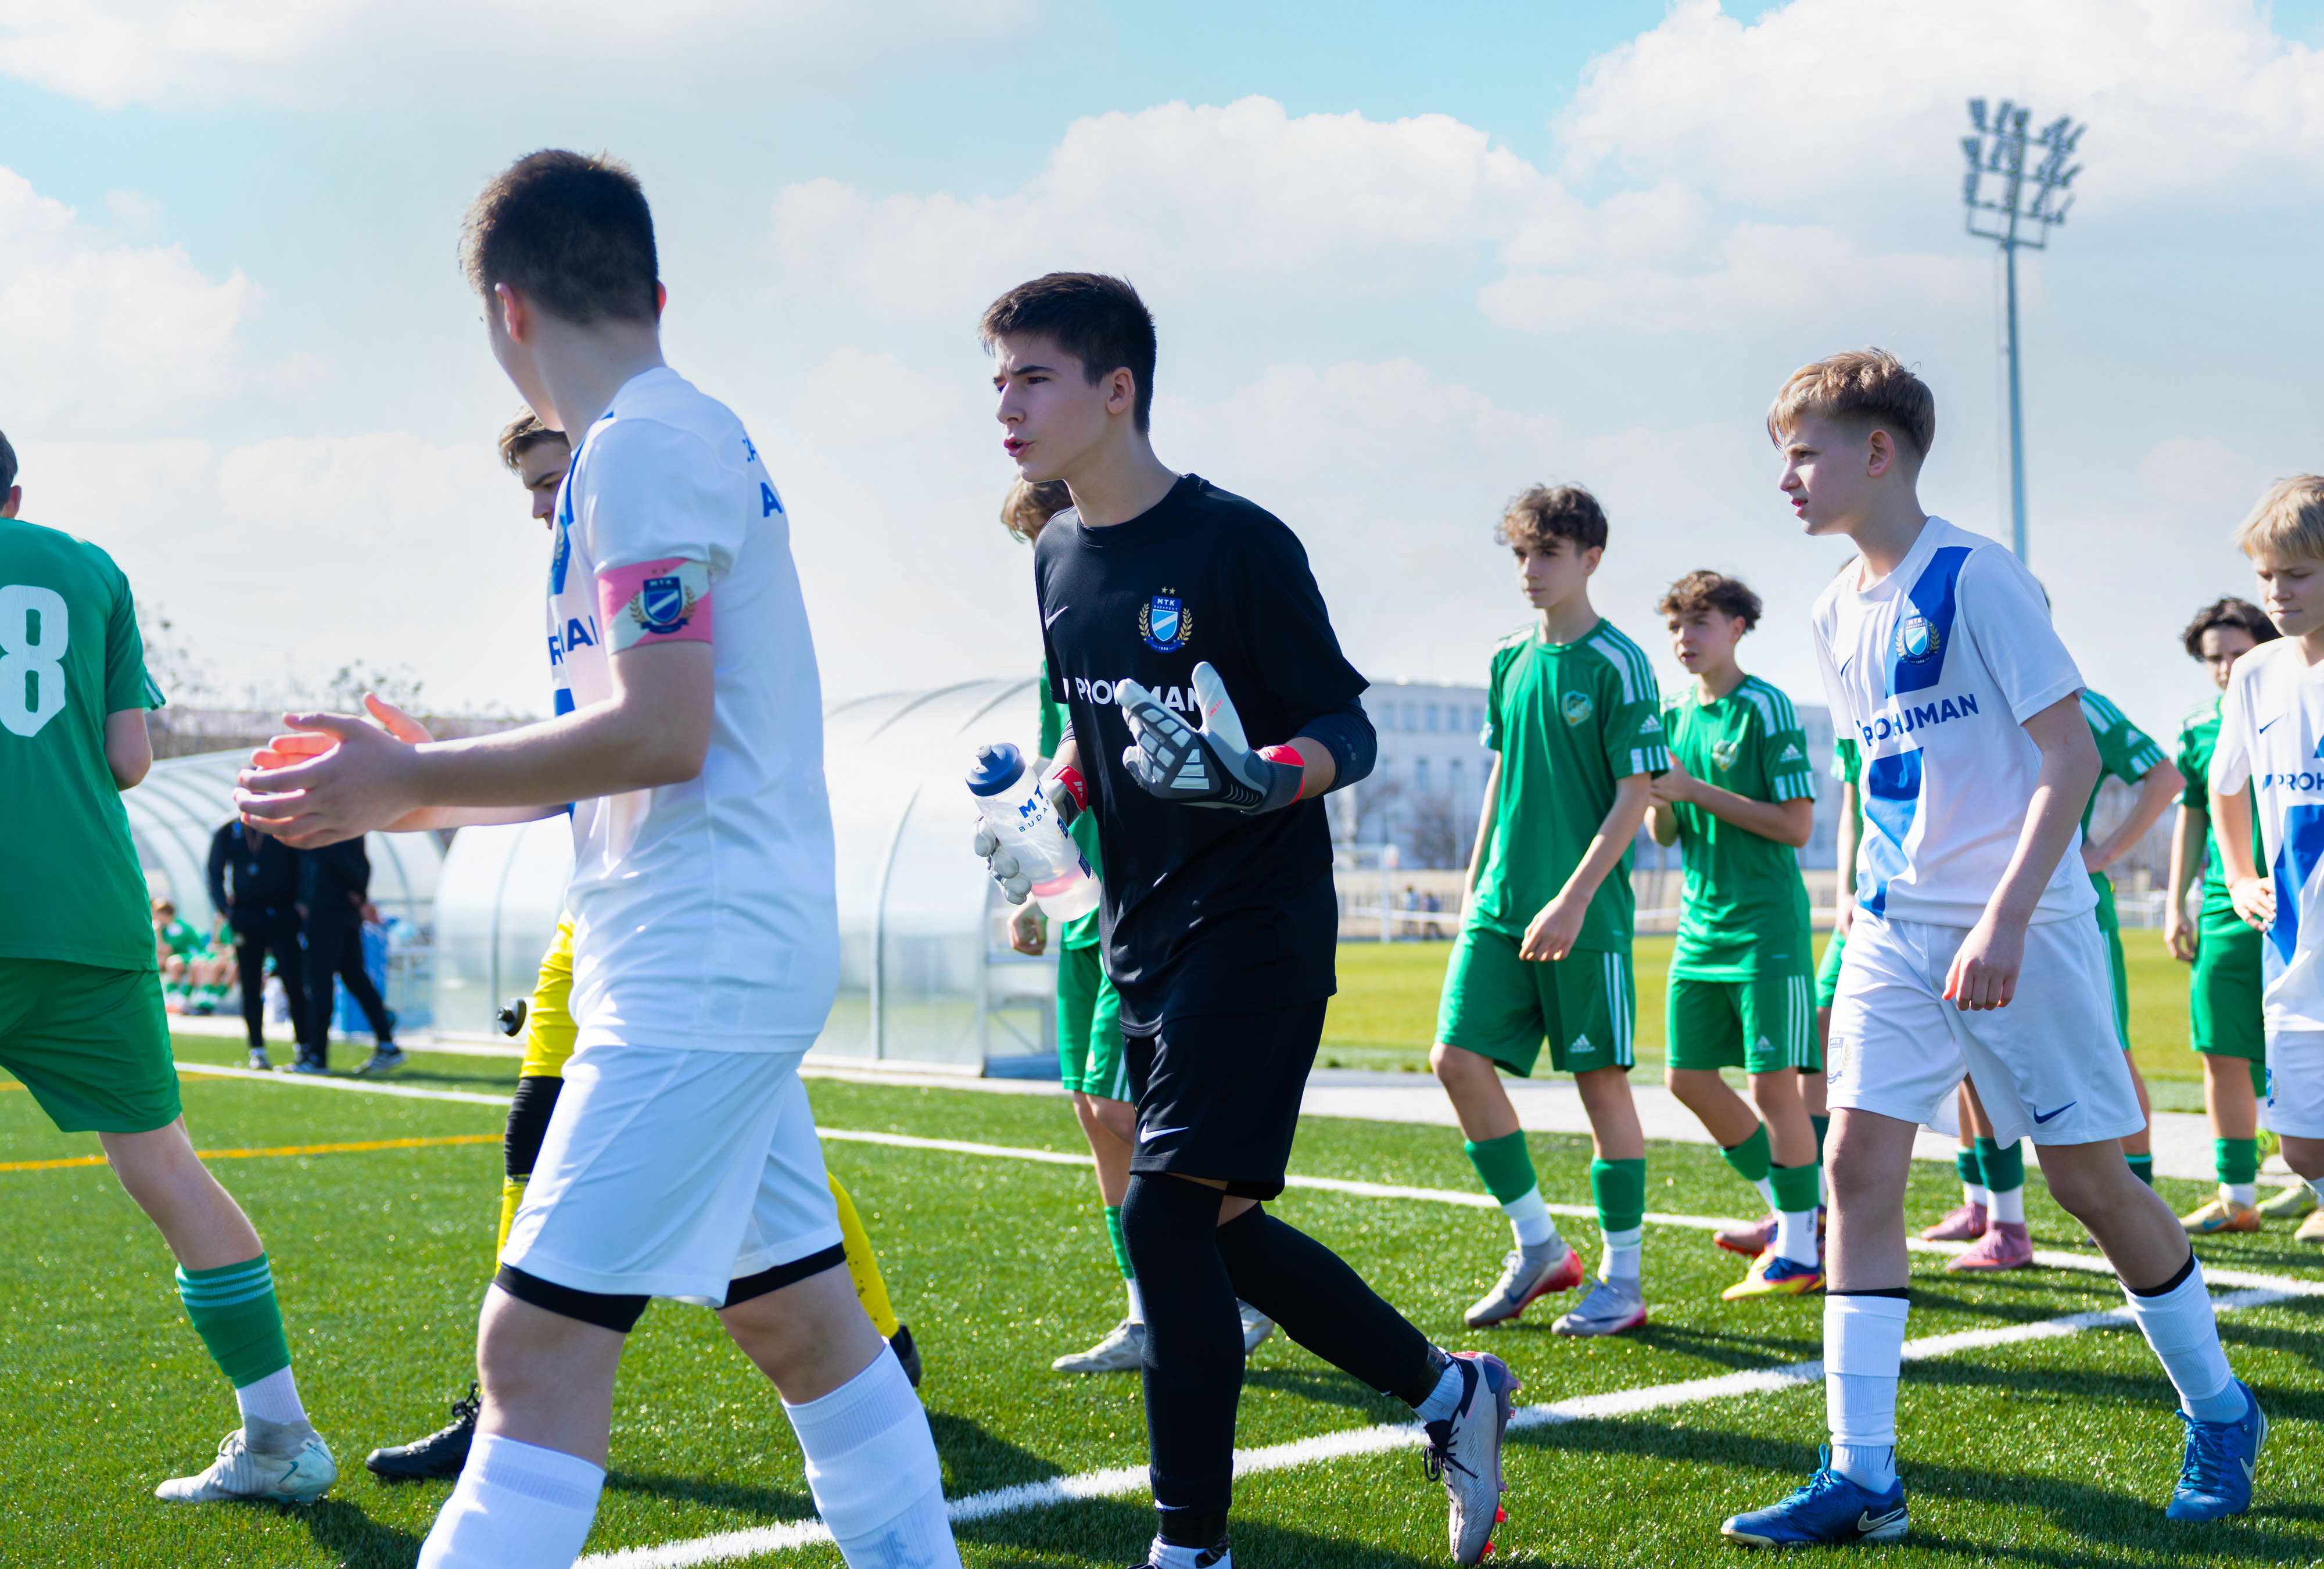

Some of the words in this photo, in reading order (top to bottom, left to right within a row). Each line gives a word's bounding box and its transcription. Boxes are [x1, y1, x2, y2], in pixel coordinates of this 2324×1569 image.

[1157, 598, 1175, 606] MTK
[1908, 617, 1923, 625] MTK
[0, 584, 69, 737] 8
